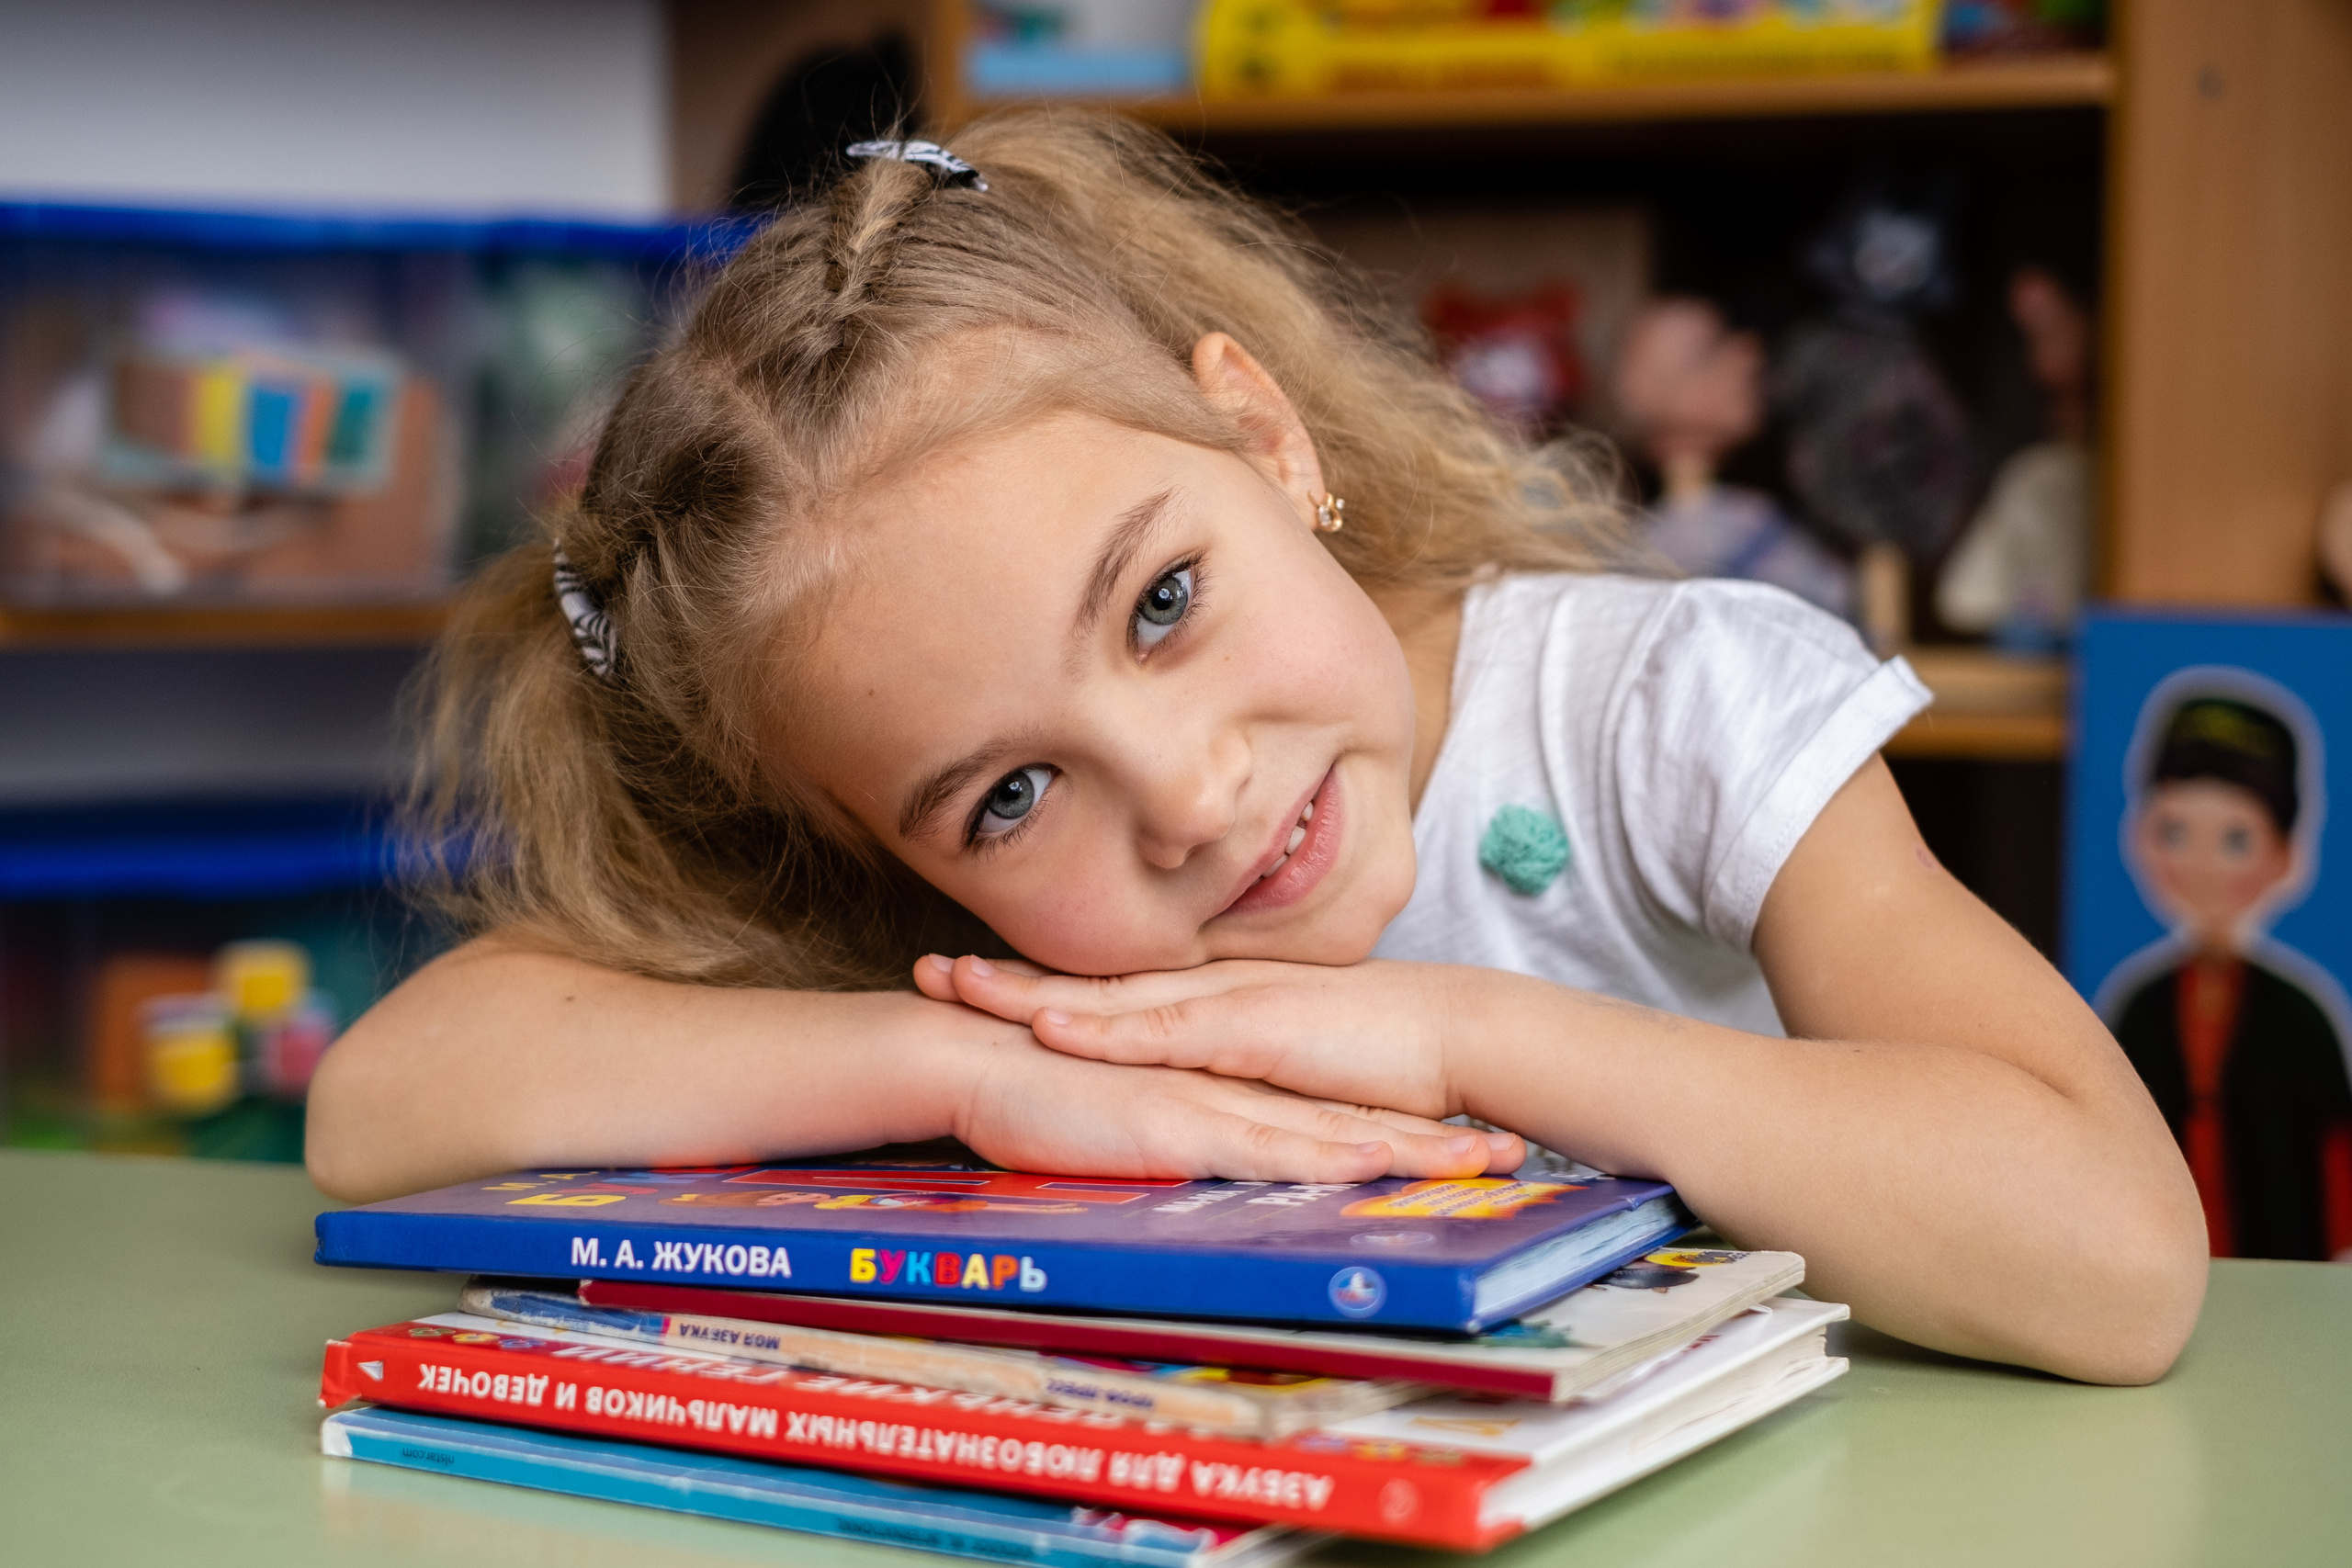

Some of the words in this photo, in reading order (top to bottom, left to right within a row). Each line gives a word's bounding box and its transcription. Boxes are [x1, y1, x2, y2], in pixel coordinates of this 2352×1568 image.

[1245, 1183, 1363, 1206] РА-М
[571, 1237, 607, 1268] М.
[614, 1240, 644, 1269] А.
[651, 1241, 792, 1279] ЖУКОВА
[849, 1247, 1048, 1294] БУКВАРЬ
[680, 1323, 741, 1345] АЗБУКА
[742, 1331, 782, 1349] МОЯ
[418, 1363, 548, 1405] ДЕВОЧЕК
[554, 1381, 578, 1411] И
[584, 1385, 778, 1439] МАЛЬЧИКОВ
[401, 1447, 456, 1467] nlstar.com
[785, 1410, 1104, 1483] ЛЮБОЗНАТЕЛЬНЫХ
[1107, 1450, 1185, 1494] ДЛЯ
[1190, 1459, 1334, 1512] АЗБУКА
